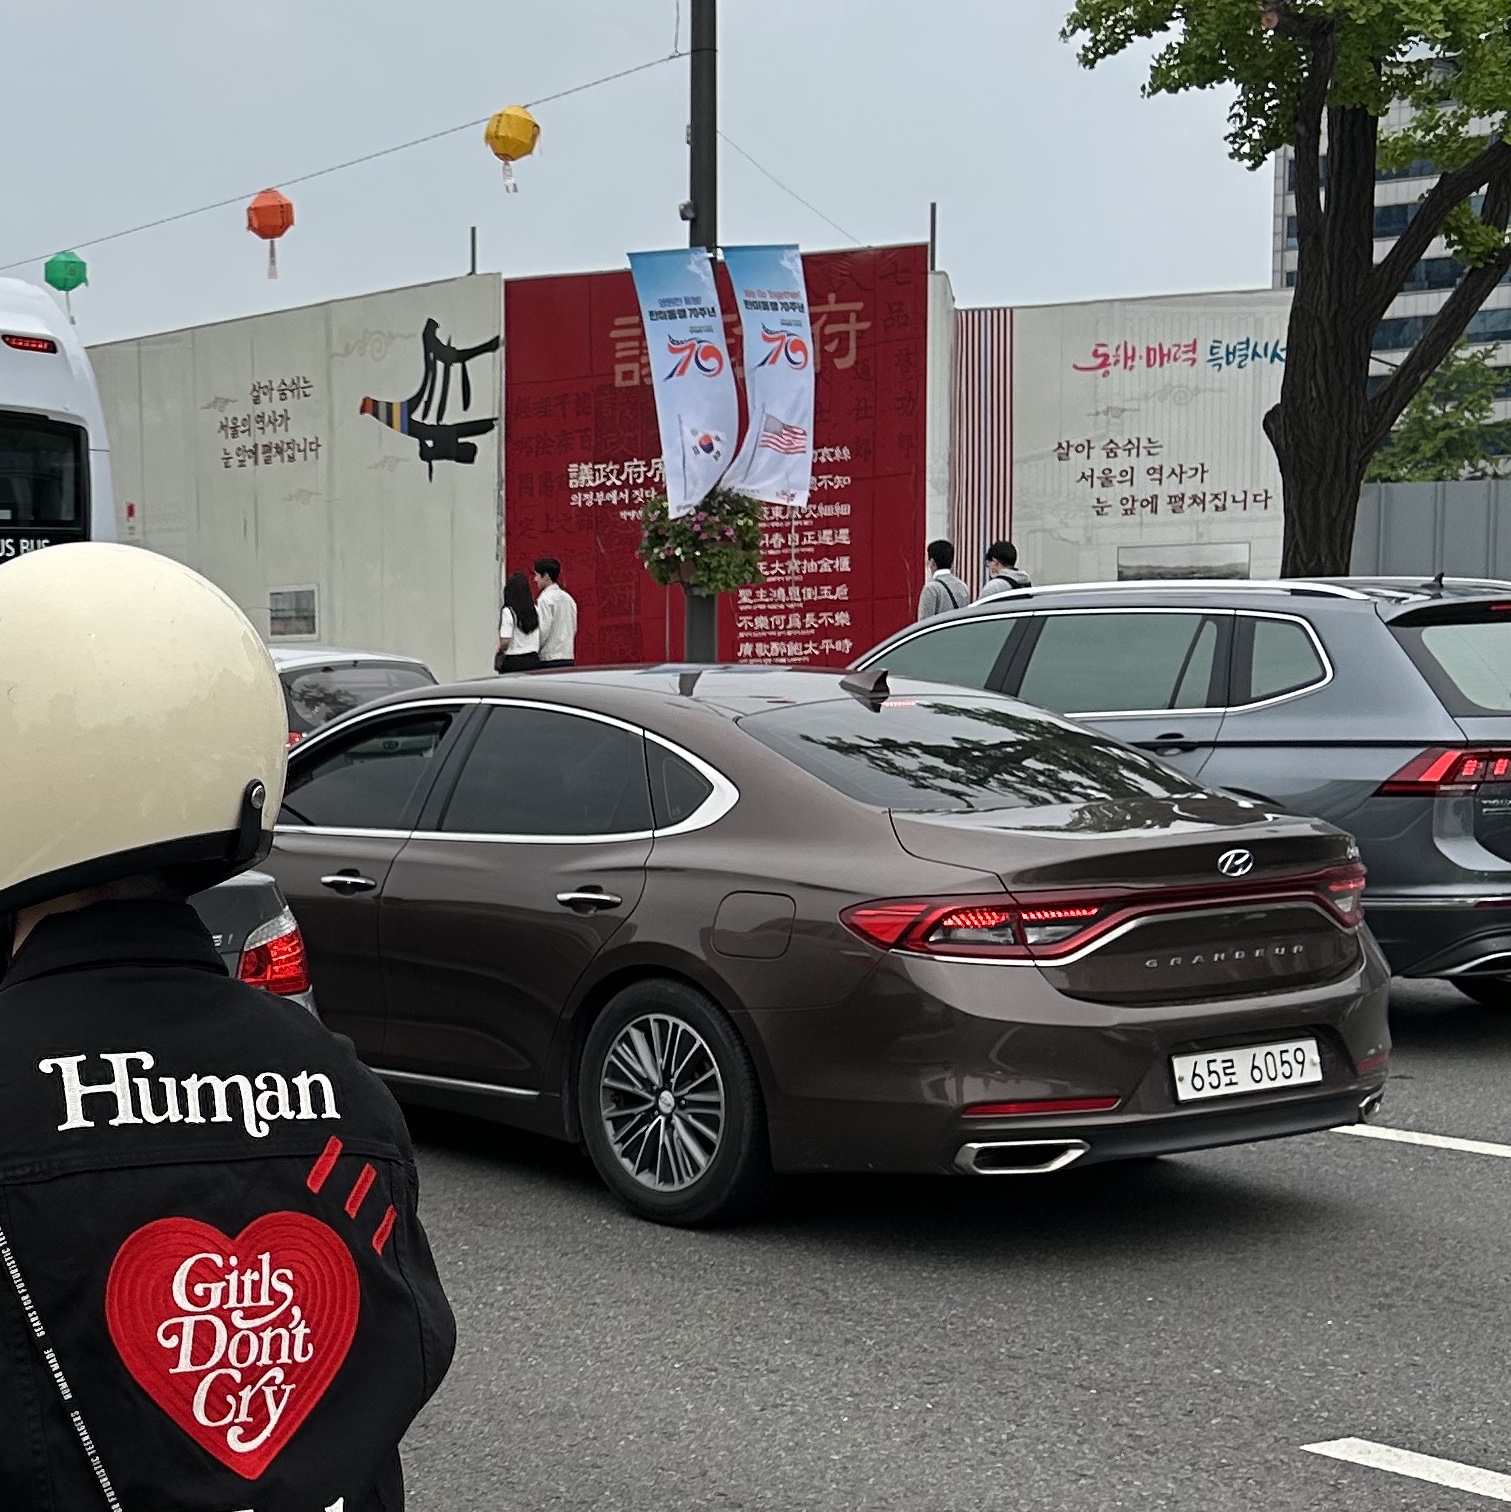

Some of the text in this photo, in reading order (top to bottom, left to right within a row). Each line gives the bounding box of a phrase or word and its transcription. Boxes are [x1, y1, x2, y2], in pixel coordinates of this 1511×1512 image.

[249, 380, 274, 405] 살아
[217, 408, 291, 440] 서울의 역사가
[221, 447, 234, 469] 눈
[1052, 437, 1164, 462] 살아 숨쉬는
[1076, 462, 1210, 489] 서울의 역사가
[1091, 488, 1273, 517] 눈 앞에 펼쳐집니다
[1145, 944, 1304, 969] GRANDEUR
[1190, 1046, 1307, 1093] 65로 6059
[39, 1051, 341, 1138] Human
[171, 1251, 296, 1326] Girls
[156, 1304, 315, 1375] Don't
[192, 1366, 296, 1454] Cry
